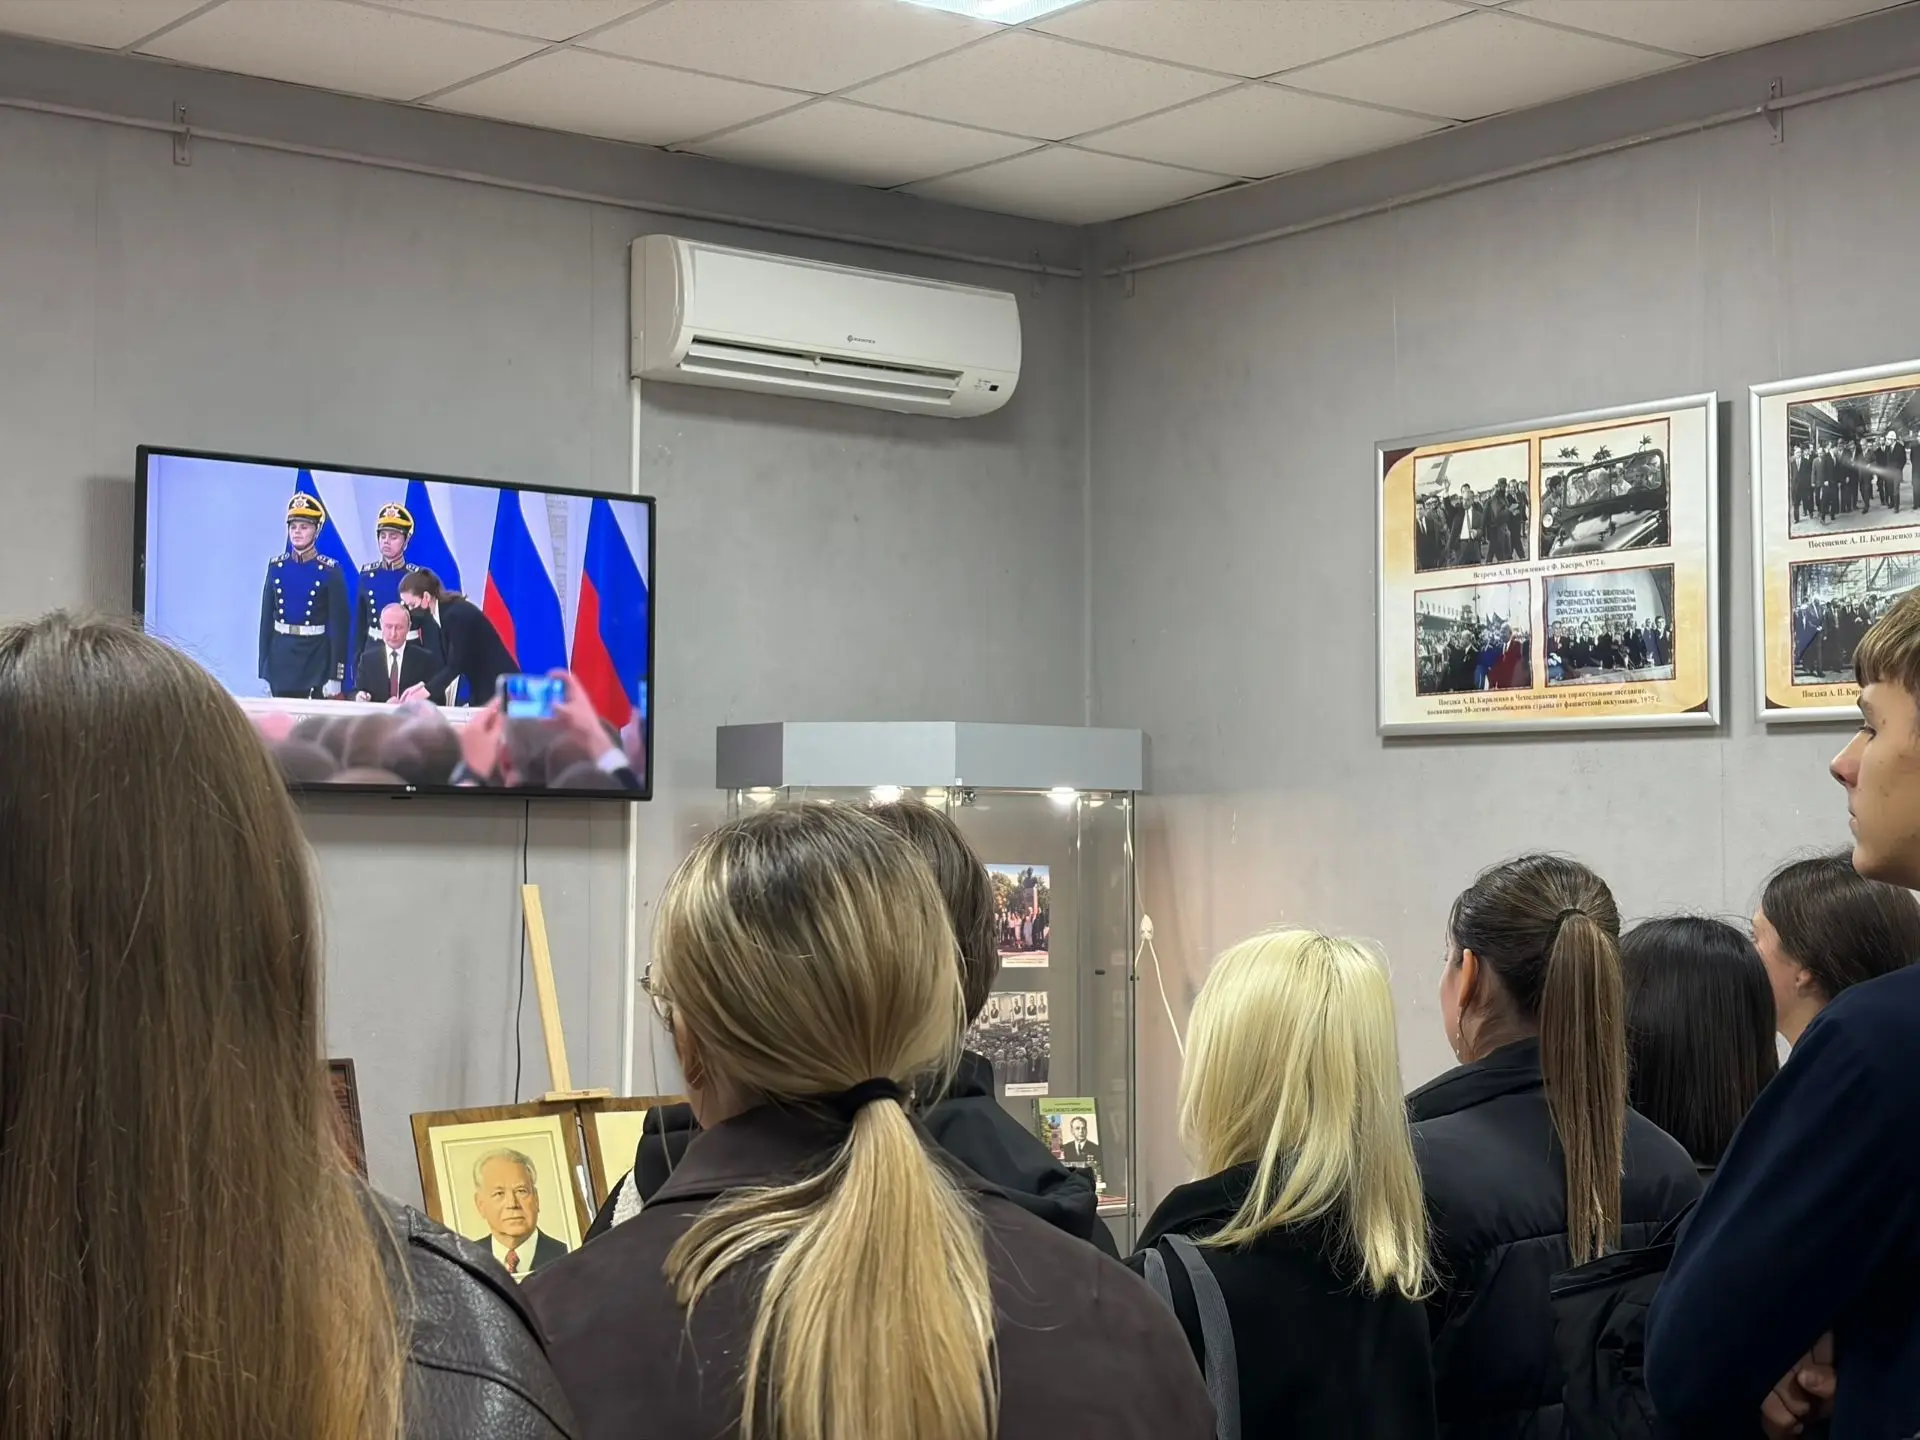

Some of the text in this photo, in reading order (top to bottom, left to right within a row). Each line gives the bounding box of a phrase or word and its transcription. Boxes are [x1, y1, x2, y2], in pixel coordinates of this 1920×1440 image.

[1860, 535, 1867, 543] П.
[1870, 532, 1913, 543] Кириленко
[1513, 567, 1546, 576] Кириленко
[1560, 561, 1584, 570] Кастро,
